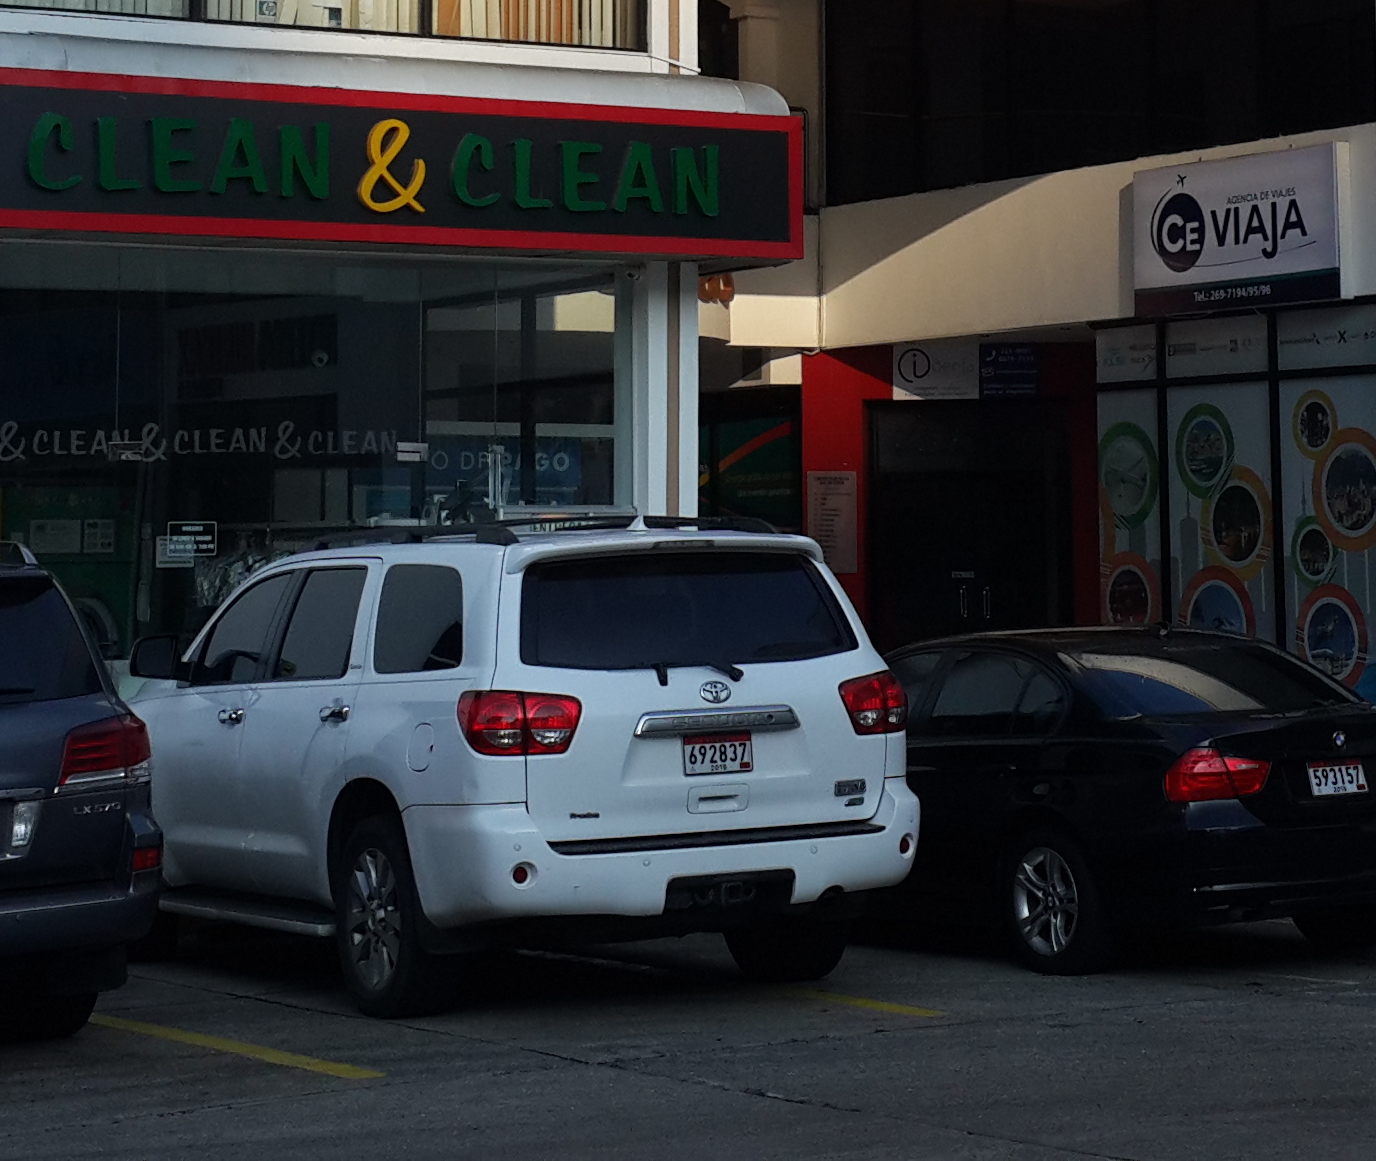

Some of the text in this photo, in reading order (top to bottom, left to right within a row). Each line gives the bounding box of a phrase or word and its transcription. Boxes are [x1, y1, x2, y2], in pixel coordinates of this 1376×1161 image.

[26, 111, 720, 217] CLEAN & CLEAN
[1226, 187, 1297, 205] AGENCIA DE VIAJES
[1162, 198, 1308, 259] CE VIAJA
[141, 422, 168, 462] &
[174, 426, 267, 455] CLEAN
[273, 420, 302, 460] &
[307, 429, 398, 455] CLEAN
[689, 742, 747, 765] 692837
[1313, 765, 1359, 787] 593157
